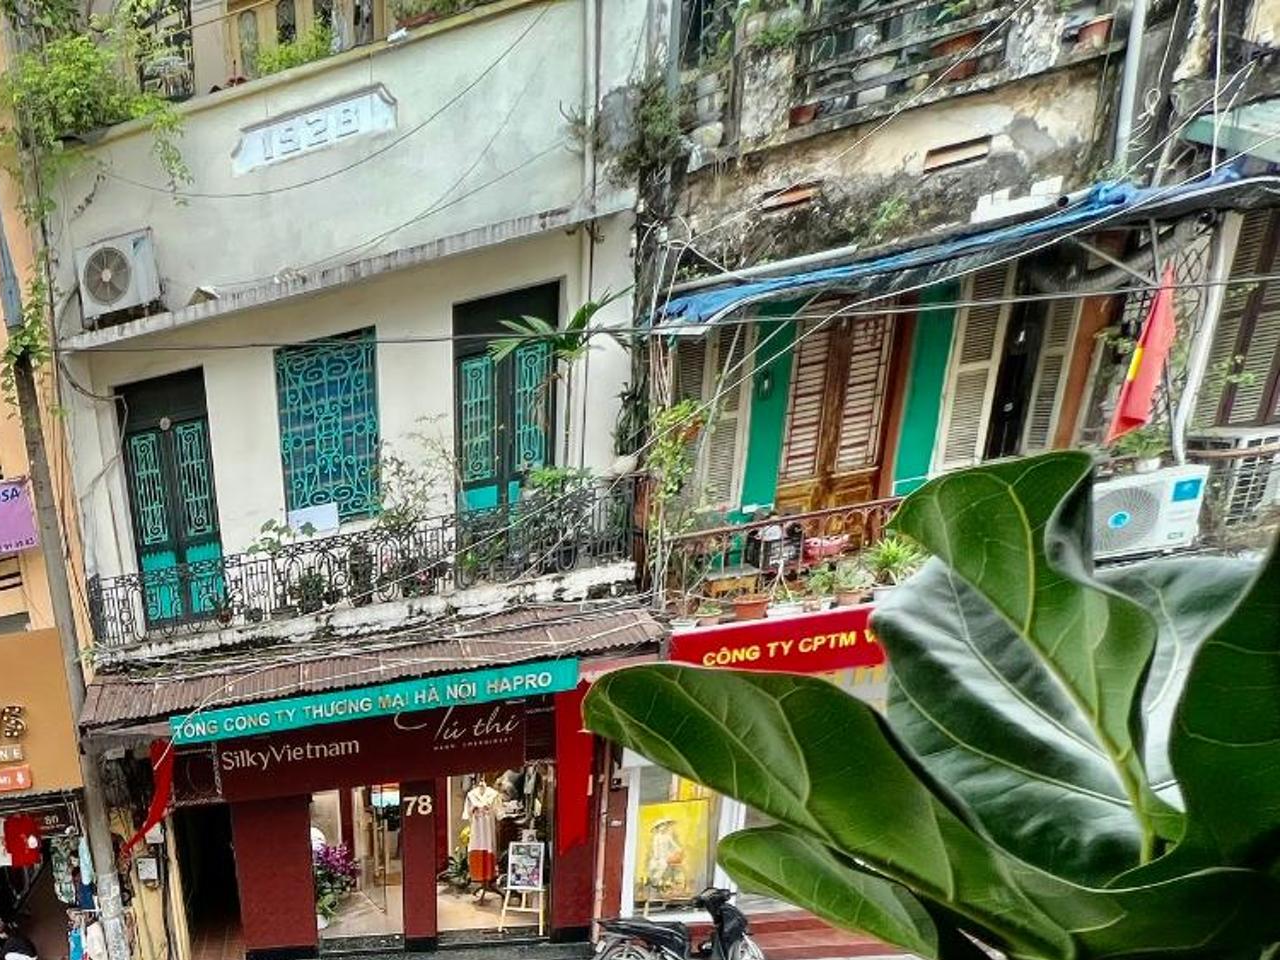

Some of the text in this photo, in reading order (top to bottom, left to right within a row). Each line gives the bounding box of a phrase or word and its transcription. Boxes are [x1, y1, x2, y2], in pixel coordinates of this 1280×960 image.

[702, 645, 761, 667] CÔNG
[767, 640, 794, 657] TY
[798, 631, 857, 653] CPTM
[223, 711, 270, 731] CÔNG
[275, 709, 296, 725] TY
[414, 686, 440, 705] HÀ
[486, 672, 553, 695] HAPRO
[403, 795, 433, 816] 78
